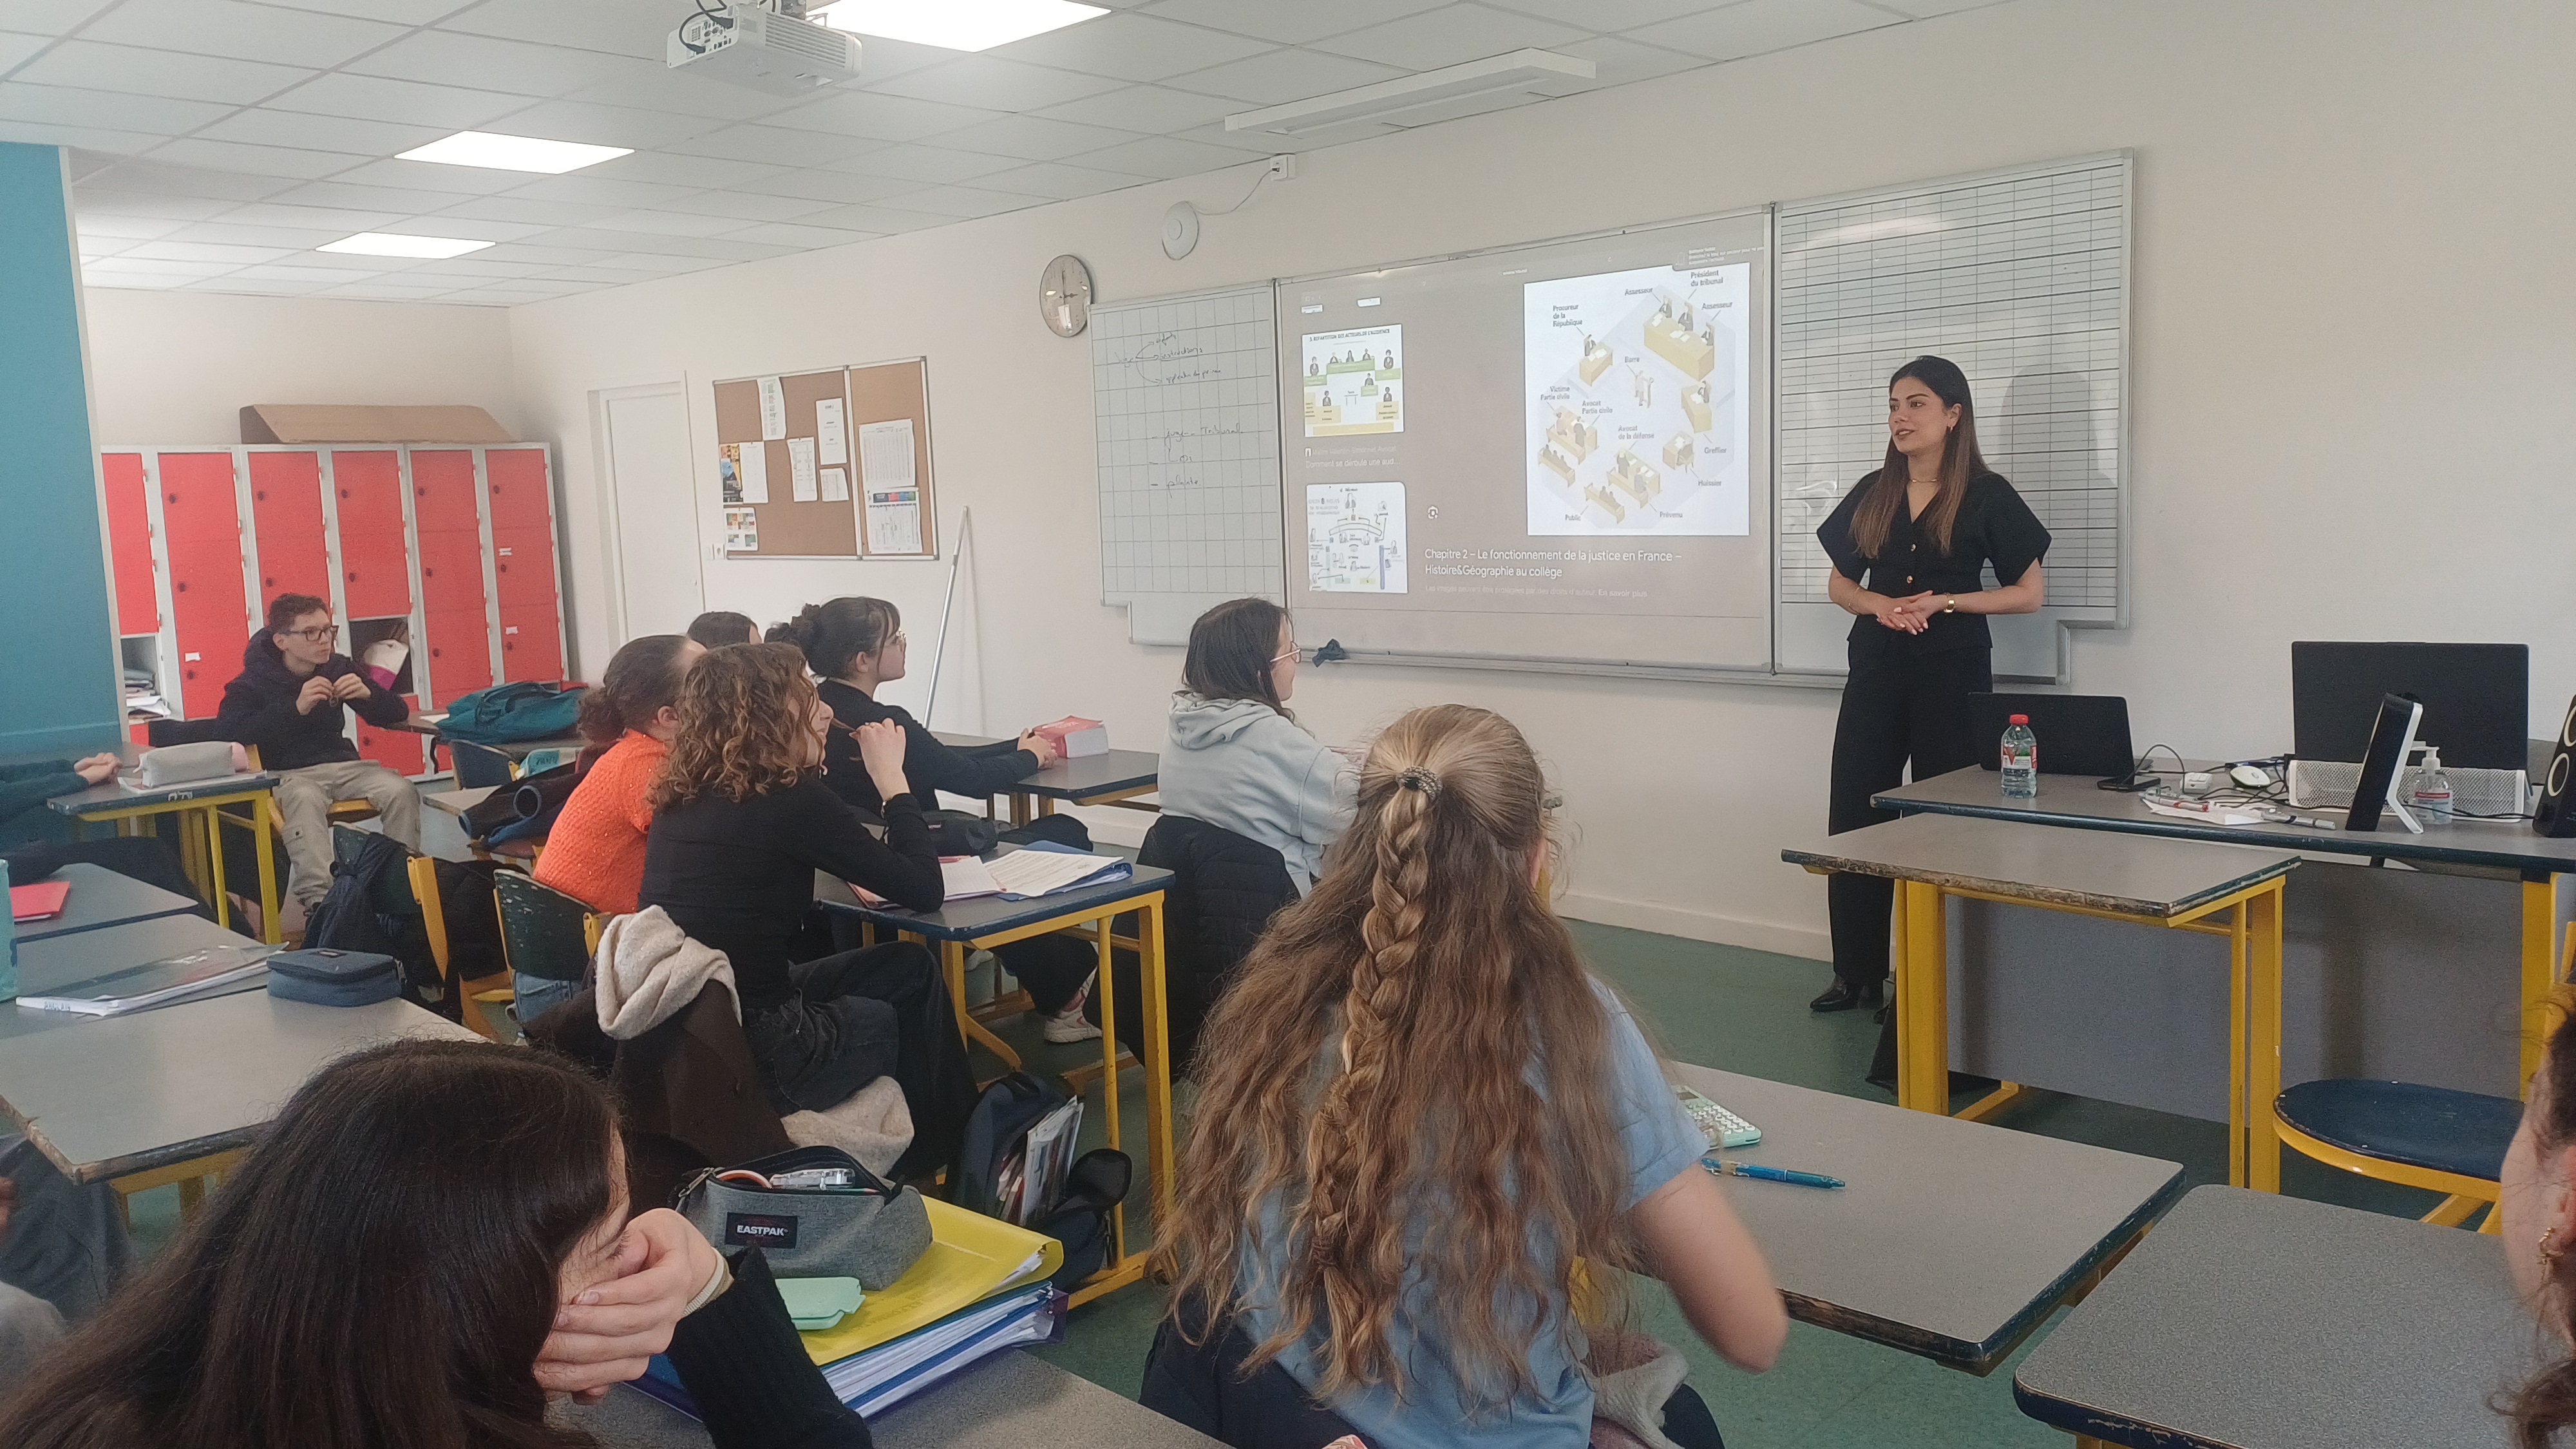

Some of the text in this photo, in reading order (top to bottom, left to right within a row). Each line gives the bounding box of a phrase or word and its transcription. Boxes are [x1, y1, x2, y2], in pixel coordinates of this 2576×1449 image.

[1690, 270, 1719, 279] Président
[1700, 277, 1723, 286] tribunal
[1553, 319, 1583, 328] République
[1344, 458, 1367, 467] déroule
[1425, 549, 1461, 562] Chapitre
[1463, 549, 1468, 559] 2
[1477, 549, 1488, 560] Le
[1490, 549, 1562, 560] fonctionnement
[1564, 550, 1577, 560] de
[1578, 550, 1586, 560] la
[1588, 550, 1620, 564] justice
[1622, 552, 1636, 561] en
[1638, 550, 1673, 562] France
[1425, 564, 1562, 580] Histoire&Géographie au collège
[1609, 589, 1630, 597] savoir
[1632, 590, 1647, 598] plus
[737, 1225, 784, 1236] EASTPAK
